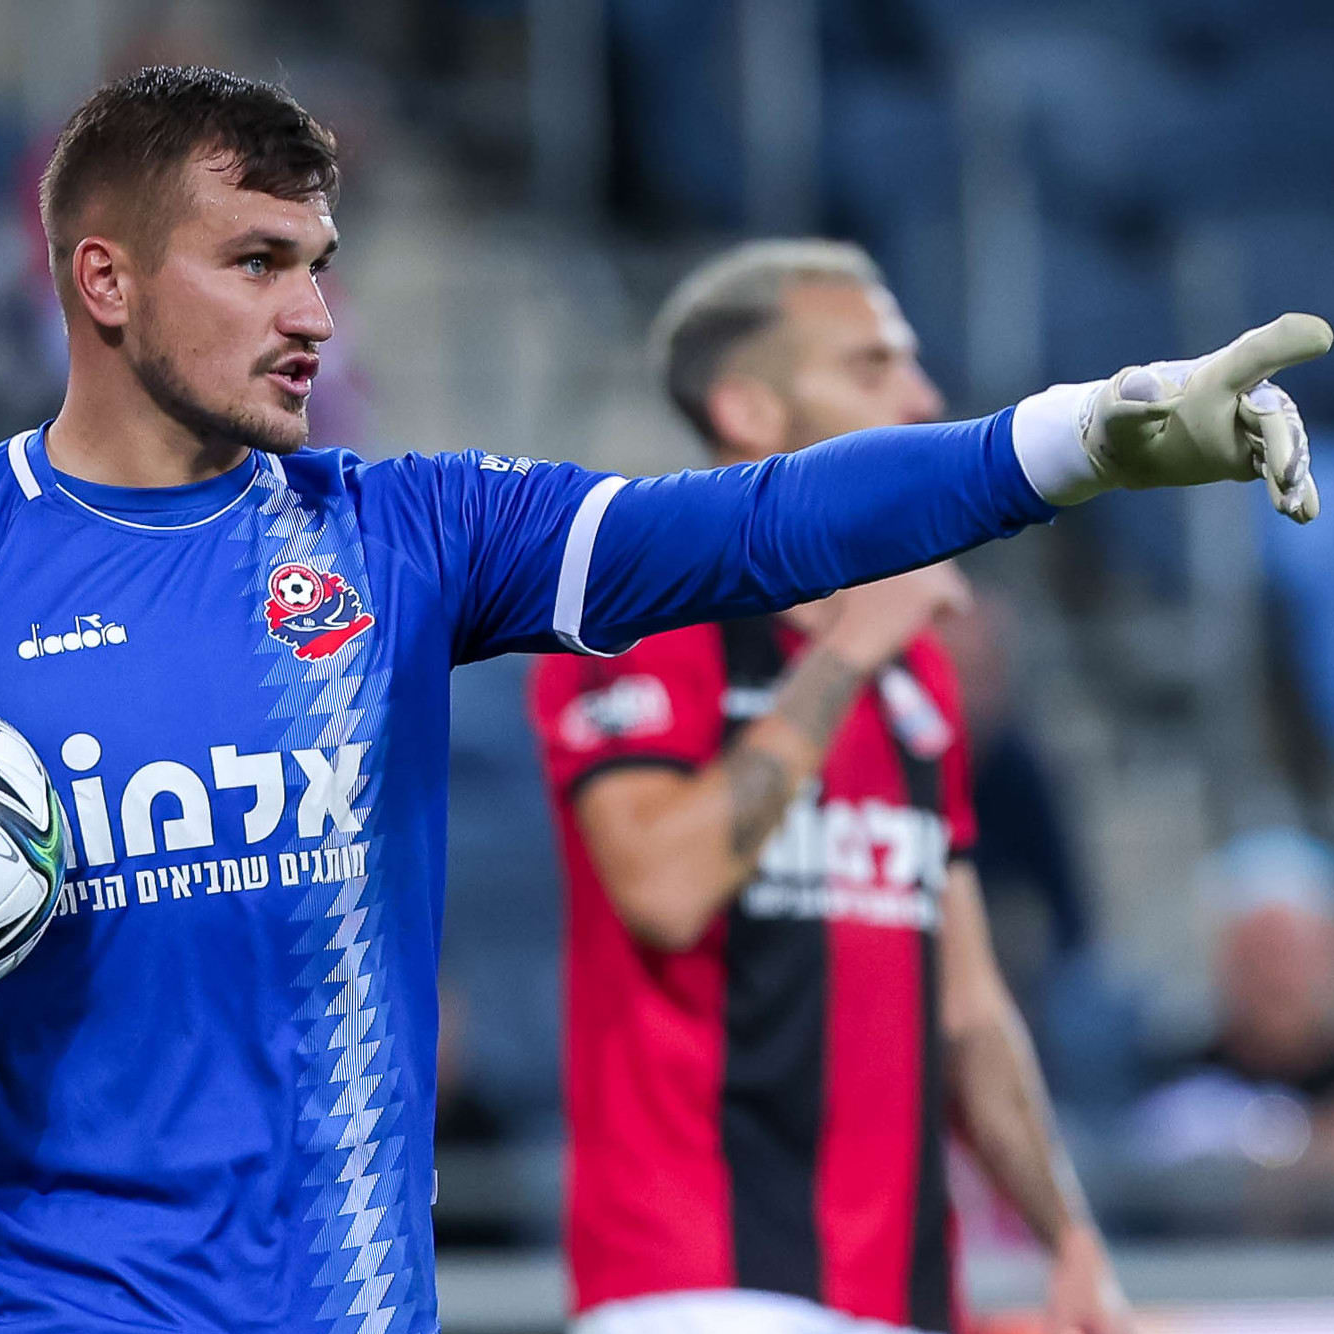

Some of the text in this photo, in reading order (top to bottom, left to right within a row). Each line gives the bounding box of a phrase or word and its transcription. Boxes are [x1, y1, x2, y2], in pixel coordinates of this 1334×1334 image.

[17, 613, 128, 660] diadora
[54, 732, 364, 869] אלמו
[52, 843, 366, 917] מותגים שמביאים הבית
